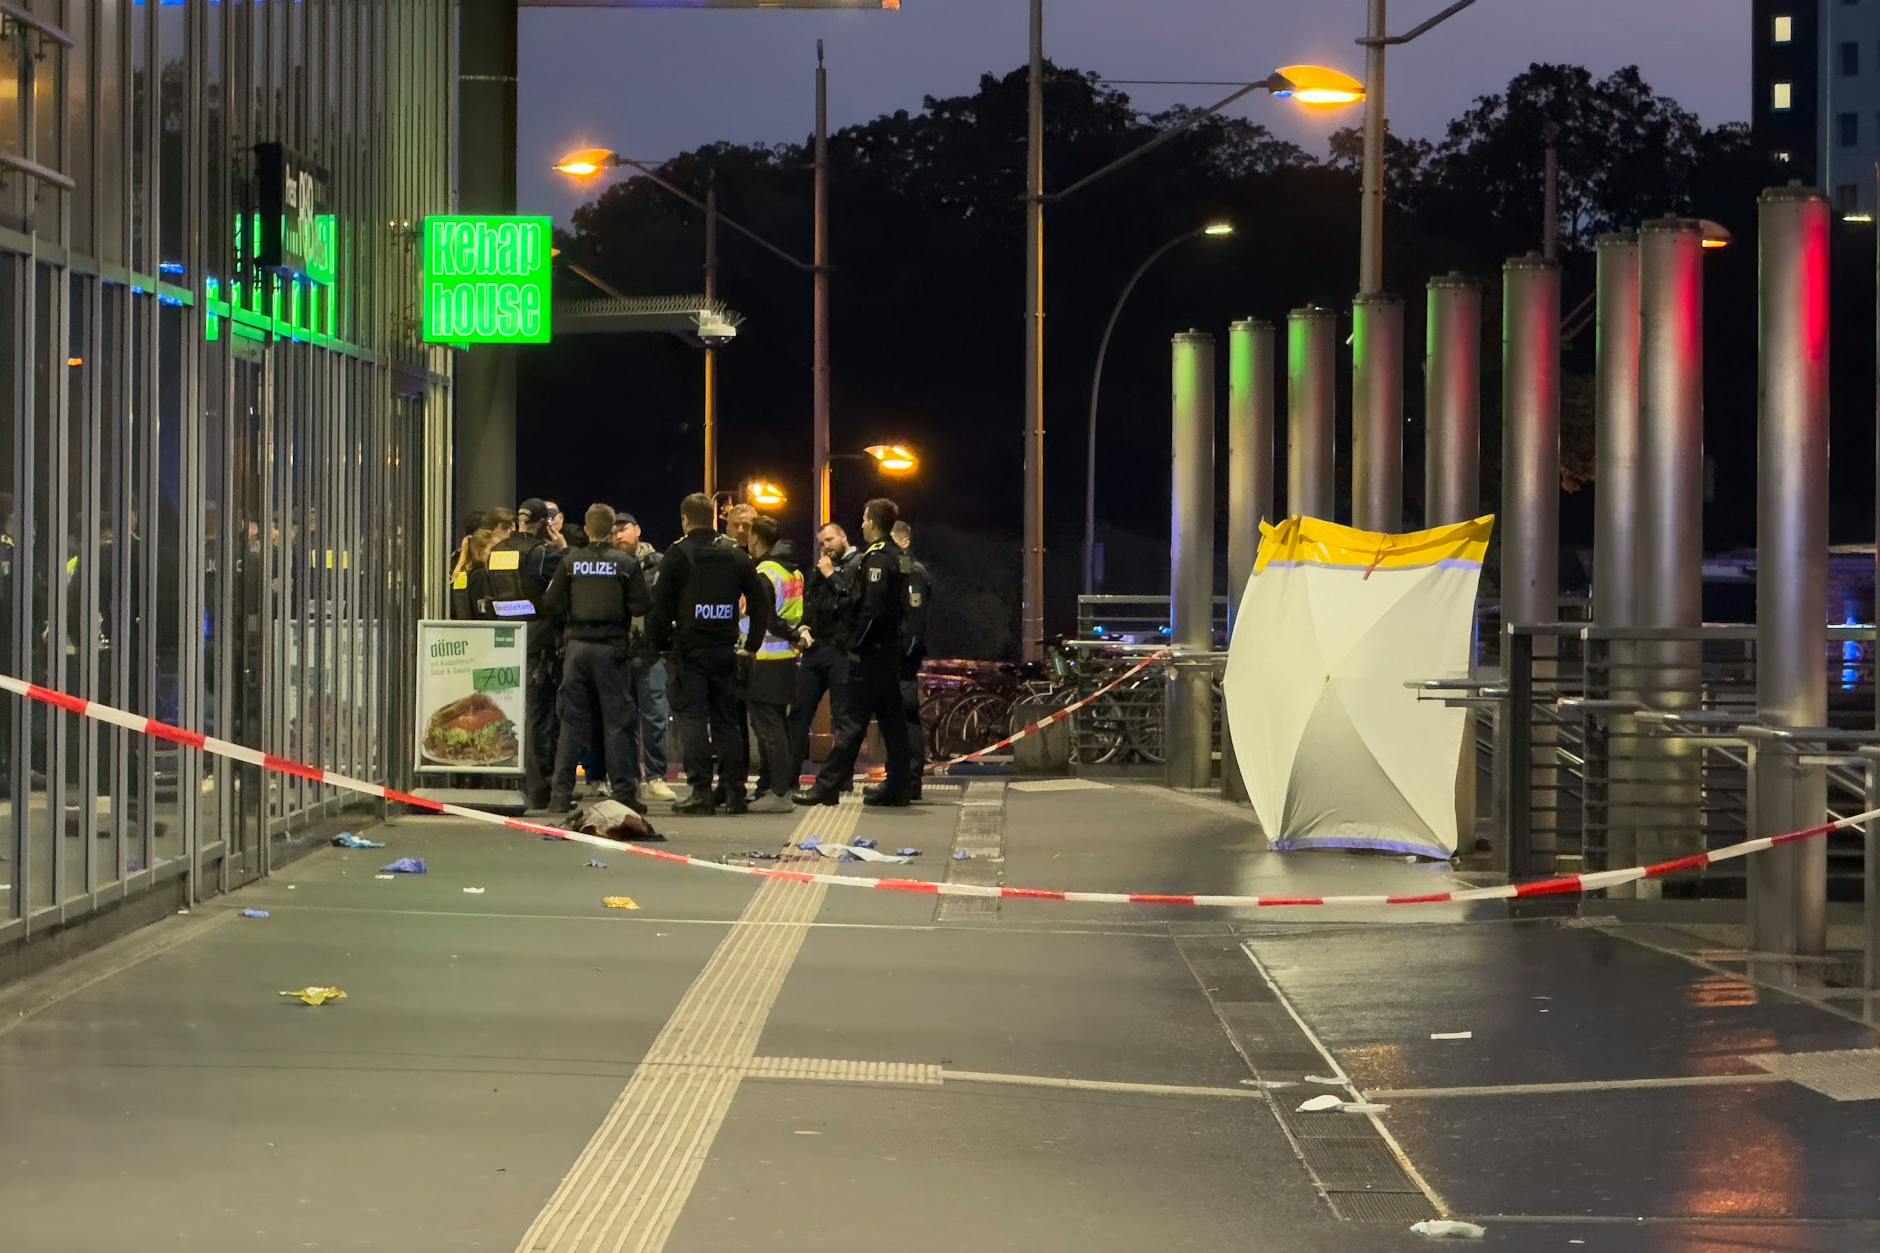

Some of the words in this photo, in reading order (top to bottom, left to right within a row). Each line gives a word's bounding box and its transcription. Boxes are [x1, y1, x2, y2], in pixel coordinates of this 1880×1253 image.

[432, 283, 541, 337] house
[573, 561, 618, 576] POLIZEI
[695, 604, 733, 620] POLIZEI
